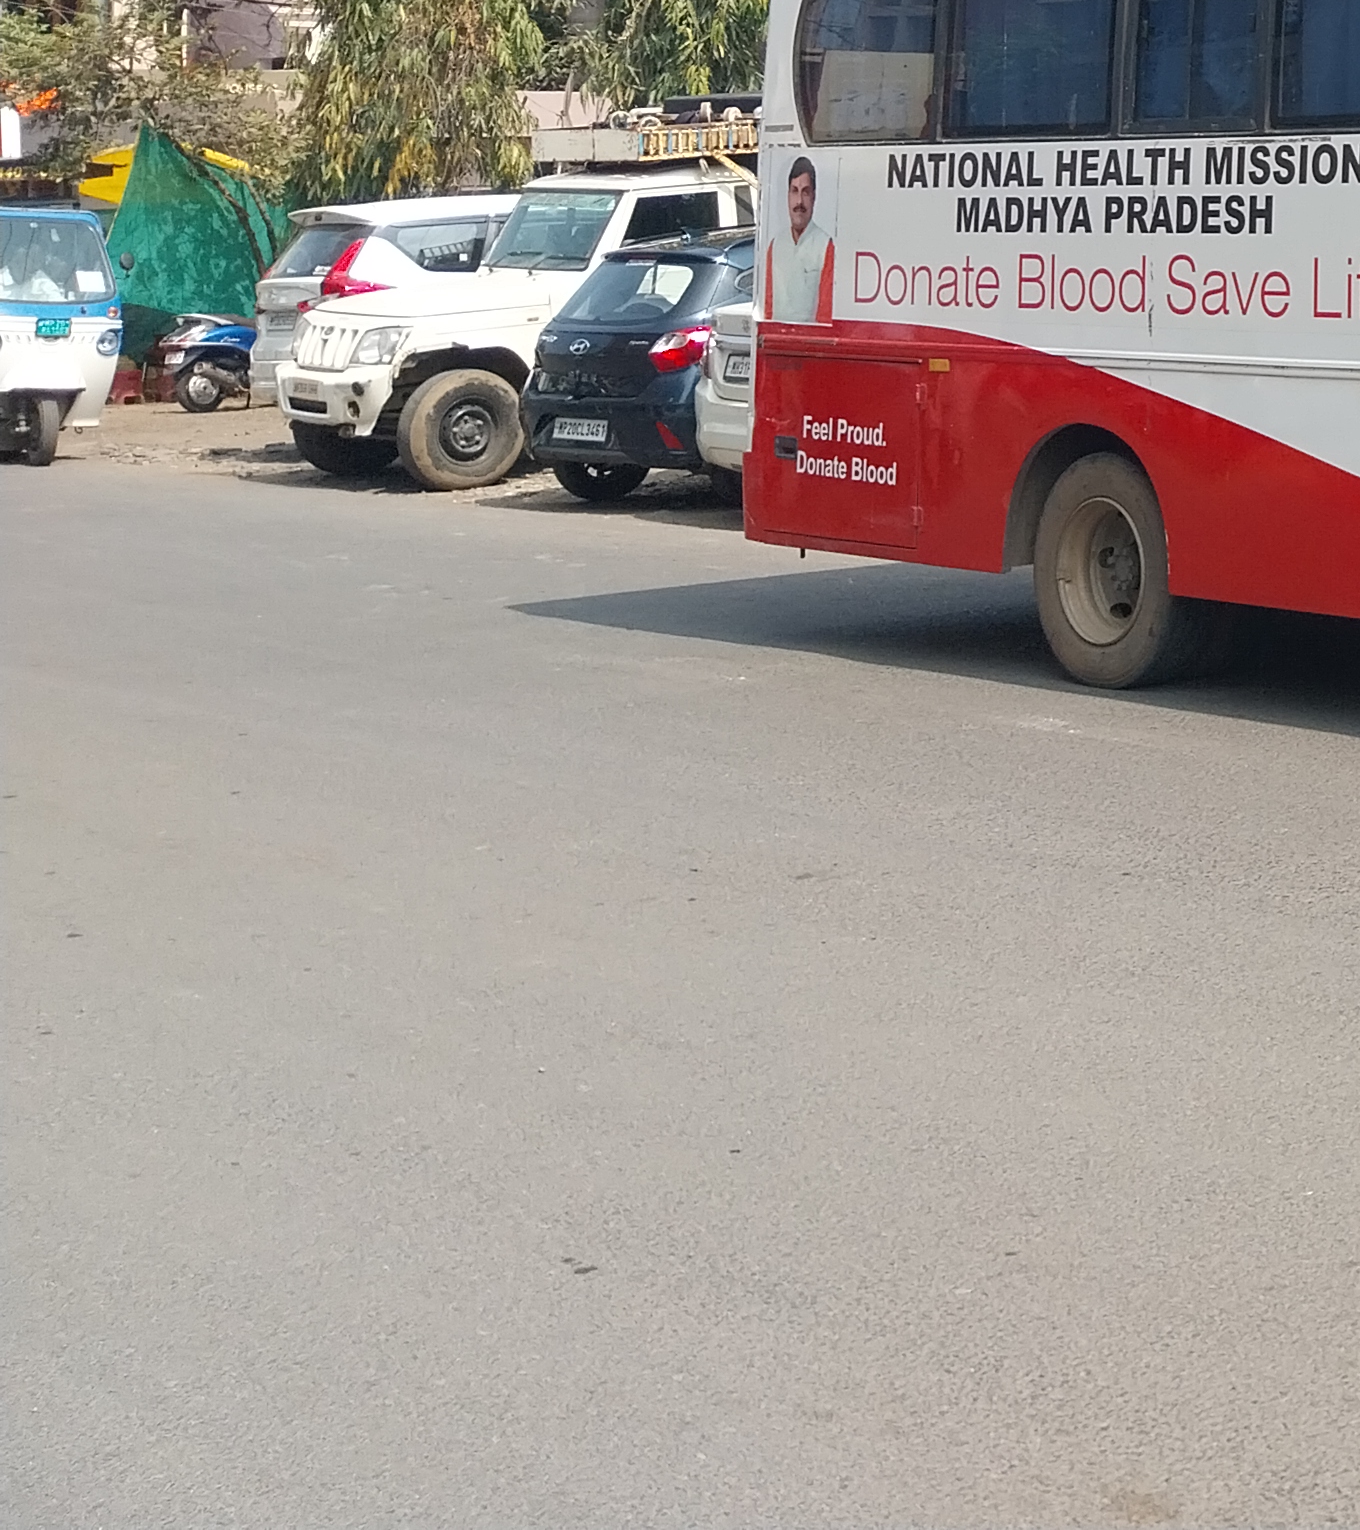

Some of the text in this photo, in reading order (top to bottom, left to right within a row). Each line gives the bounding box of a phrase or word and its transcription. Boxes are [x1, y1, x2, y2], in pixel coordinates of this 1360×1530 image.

[887, 150, 1044, 189] NATIONAL
[1055, 147, 1192, 187] HEALTH
[956, 195, 1273, 235] MADHYA PRADESH
[853, 251, 1000, 309] Donate
[1017, 253, 1147, 314] Blood
[1166, 254, 1291, 319] Save
[803, 415, 887, 447] Feel Proud.
[796, 450, 897, 486] Donate Blood
